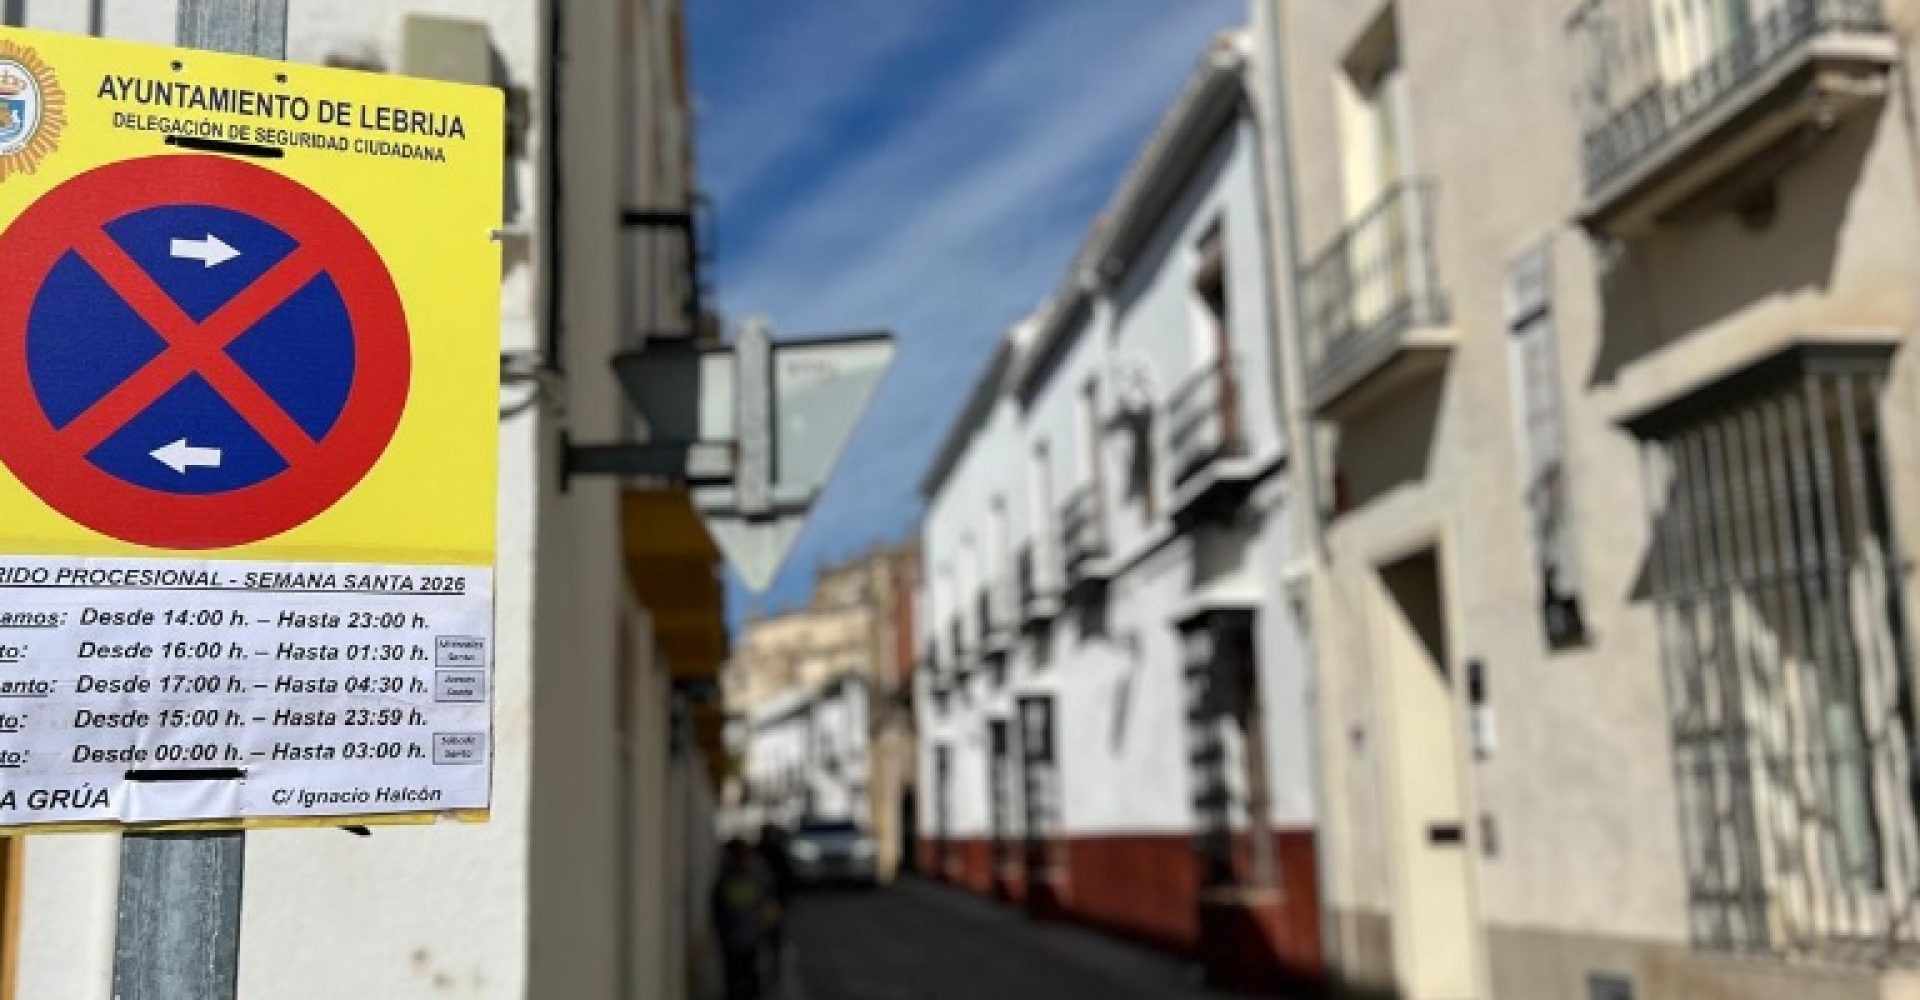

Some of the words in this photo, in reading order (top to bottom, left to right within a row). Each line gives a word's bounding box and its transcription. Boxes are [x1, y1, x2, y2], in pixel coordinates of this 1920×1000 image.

[97, 74, 309, 121] AYUNTAMIENTO
[317, 99, 351, 126] DE
[360, 104, 466, 140] LEBRIJA
[113, 111, 223, 138] DELEGACIÓN
[228, 124, 251, 141] DE
[255, 127, 348, 151] SEGURIDAD
[355, 138, 446, 163] CIUDADANA
[55, 569, 223, 586] PROCESIONAL
[244, 572, 336, 589] SEMANA
[344, 574, 414, 591] SANTA
[419, 576, 466, 592] 2026
[80, 607, 153, 626] Desde
[164, 609, 223, 626] 14:00
[229, 609, 249, 627] h.
[277, 610, 340, 628] Hasta
[347, 611, 406, 629] 23:00
[412, 611, 430, 629] h.
[78, 642, 153, 659] Desde
[162, 642, 223, 658] 16:00
[228, 642, 248, 659] h.
[275, 642, 338, 661] Hasta
[346, 644, 402, 661] 01:30
[410, 643, 429, 661] h.
[75, 675, 151, 693] Desde
[160, 674, 220, 693] 17:00
[226, 674, 246, 693] h.
[274, 674, 338, 693] Hasta
[344, 675, 403, 693] 04:30
[409, 675, 428, 693] h.
[74, 709, 149, 729] Desde
[158, 709, 219, 728] 15:00
[225, 709, 245, 728] h.
[272, 708, 336, 726] Hasta
[344, 708, 403, 726] 23:59
[408, 707, 428, 726] h.
[72, 744, 148, 763] Desde
[154, 744, 218, 761] 00:00
[224, 744, 243, 761] h.
[272, 742, 335, 760] Hasta
[342, 742, 401, 759] 03:00
[407, 742, 426, 759] h.
[0, 790, 16, 810] A
[27, 782, 110, 810] GRÚA
[272, 787, 294, 804] C/
[297, 786, 370, 808] Ignacio
[375, 785, 442, 803] Halcón
